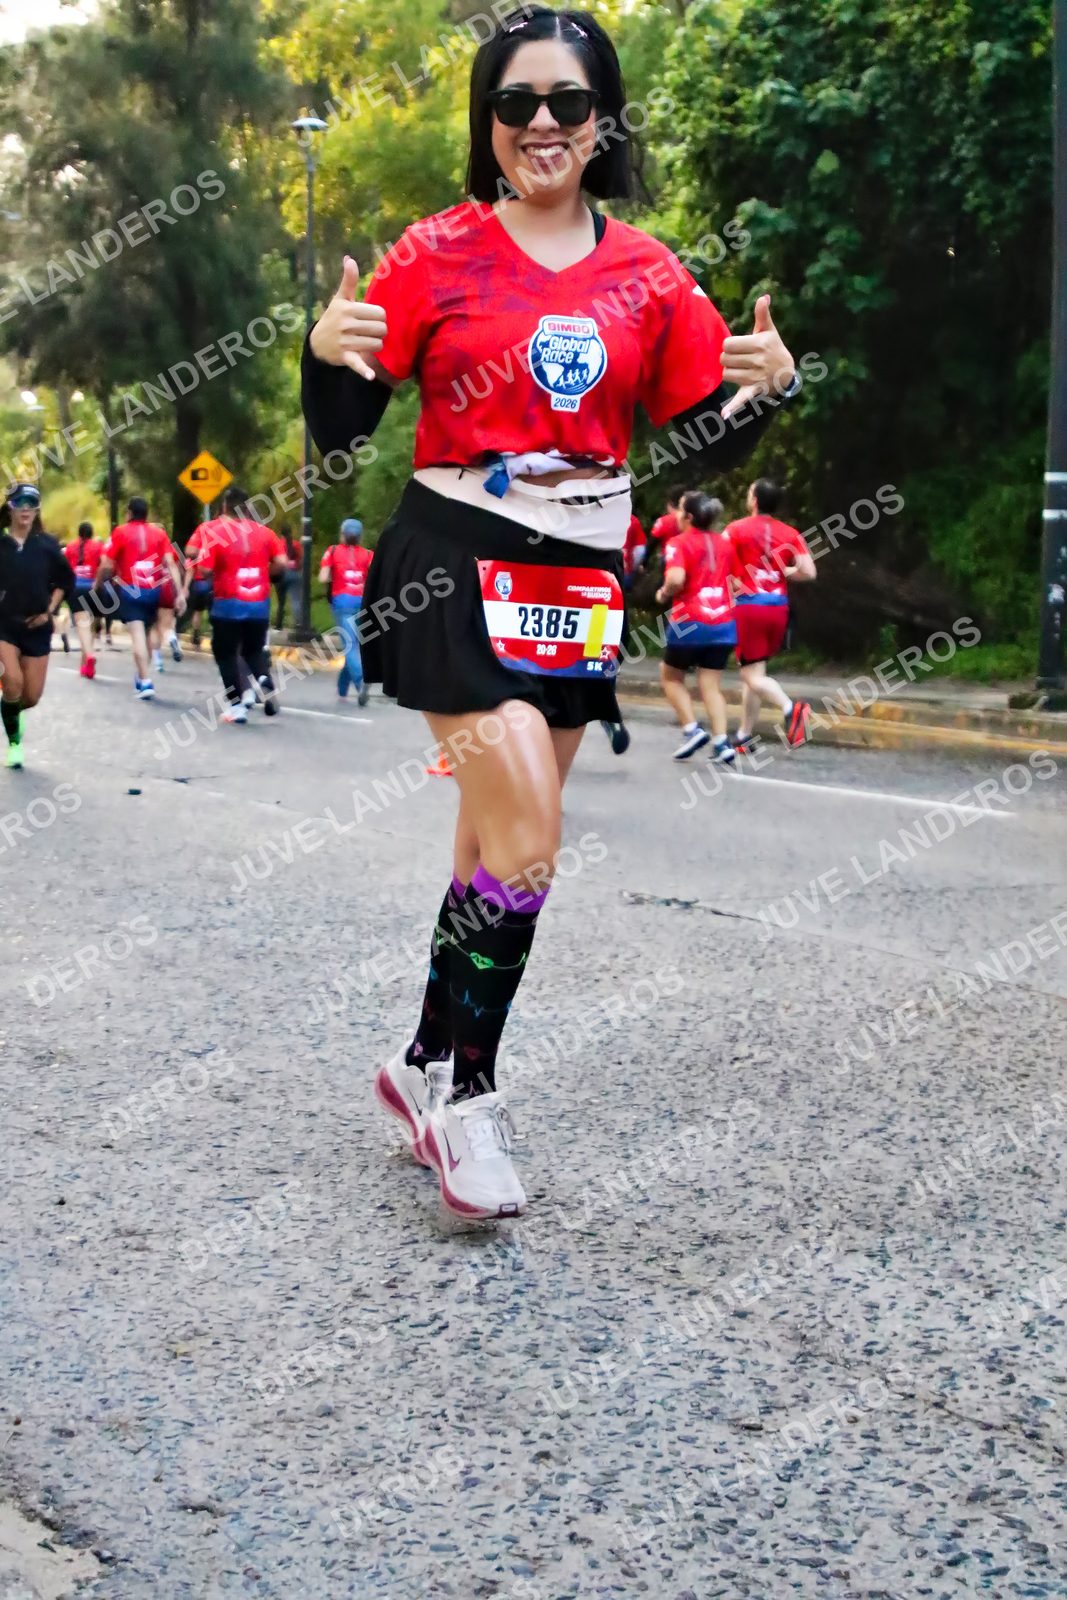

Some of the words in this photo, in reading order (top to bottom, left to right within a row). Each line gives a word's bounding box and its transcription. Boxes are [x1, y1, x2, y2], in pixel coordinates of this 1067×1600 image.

[548, 322, 590, 334] BIMBO
[549, 336, 590, 354] Global
[541, 347, 573, 363] Race
[554, 397, 578, 409] 2026
[518, 606, 580, 639] 2385
[586, 661, 603, 671] 5K
